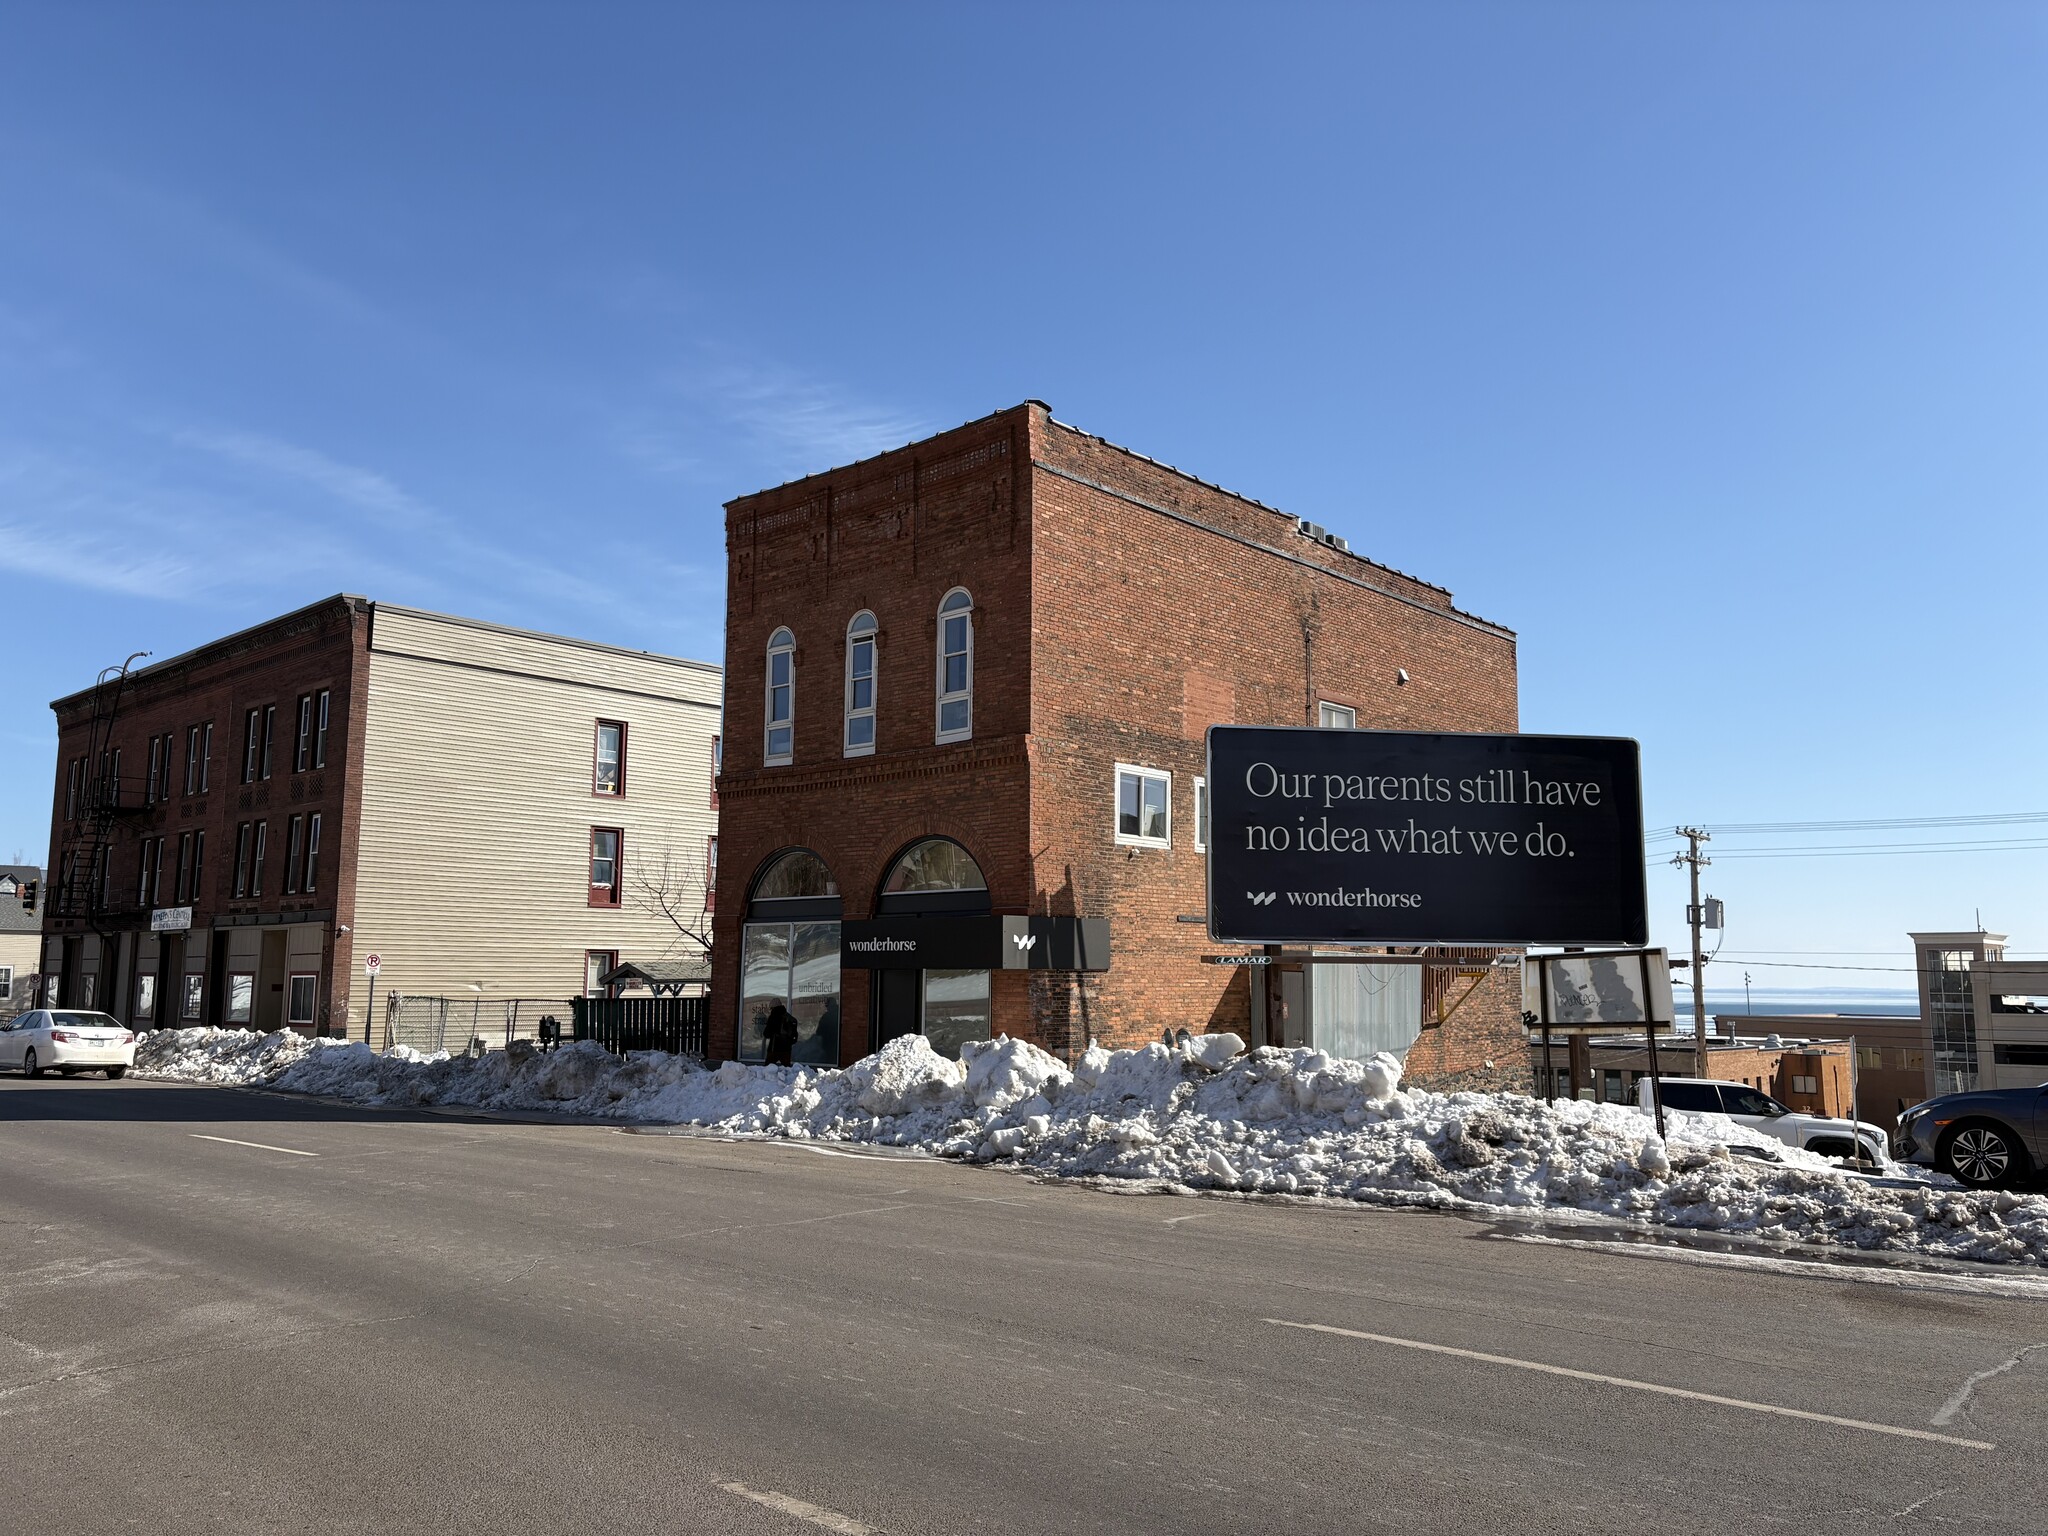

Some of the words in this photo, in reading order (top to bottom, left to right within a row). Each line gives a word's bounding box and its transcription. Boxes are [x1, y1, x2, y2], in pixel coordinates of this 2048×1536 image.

[1246, 762, 1316, 798] Our
[1323, 773, 1451, 808] parents
[1459, 769, 1517, 804] still
[1523, 770, 1601, 806] have
[1246, 825, 1290, 851] no
[1297, 816, 1371, 853] idea
[1375, 818, 1463, 855] what
[1467, 831, 1518, 856] we
[1525, 822, 1575, 857] do.
[1286, 887, 1422, 908] wonderhorse
[849, 936, 916, 951] wonderhorse
[798, 982, 833, 993] unbridled
